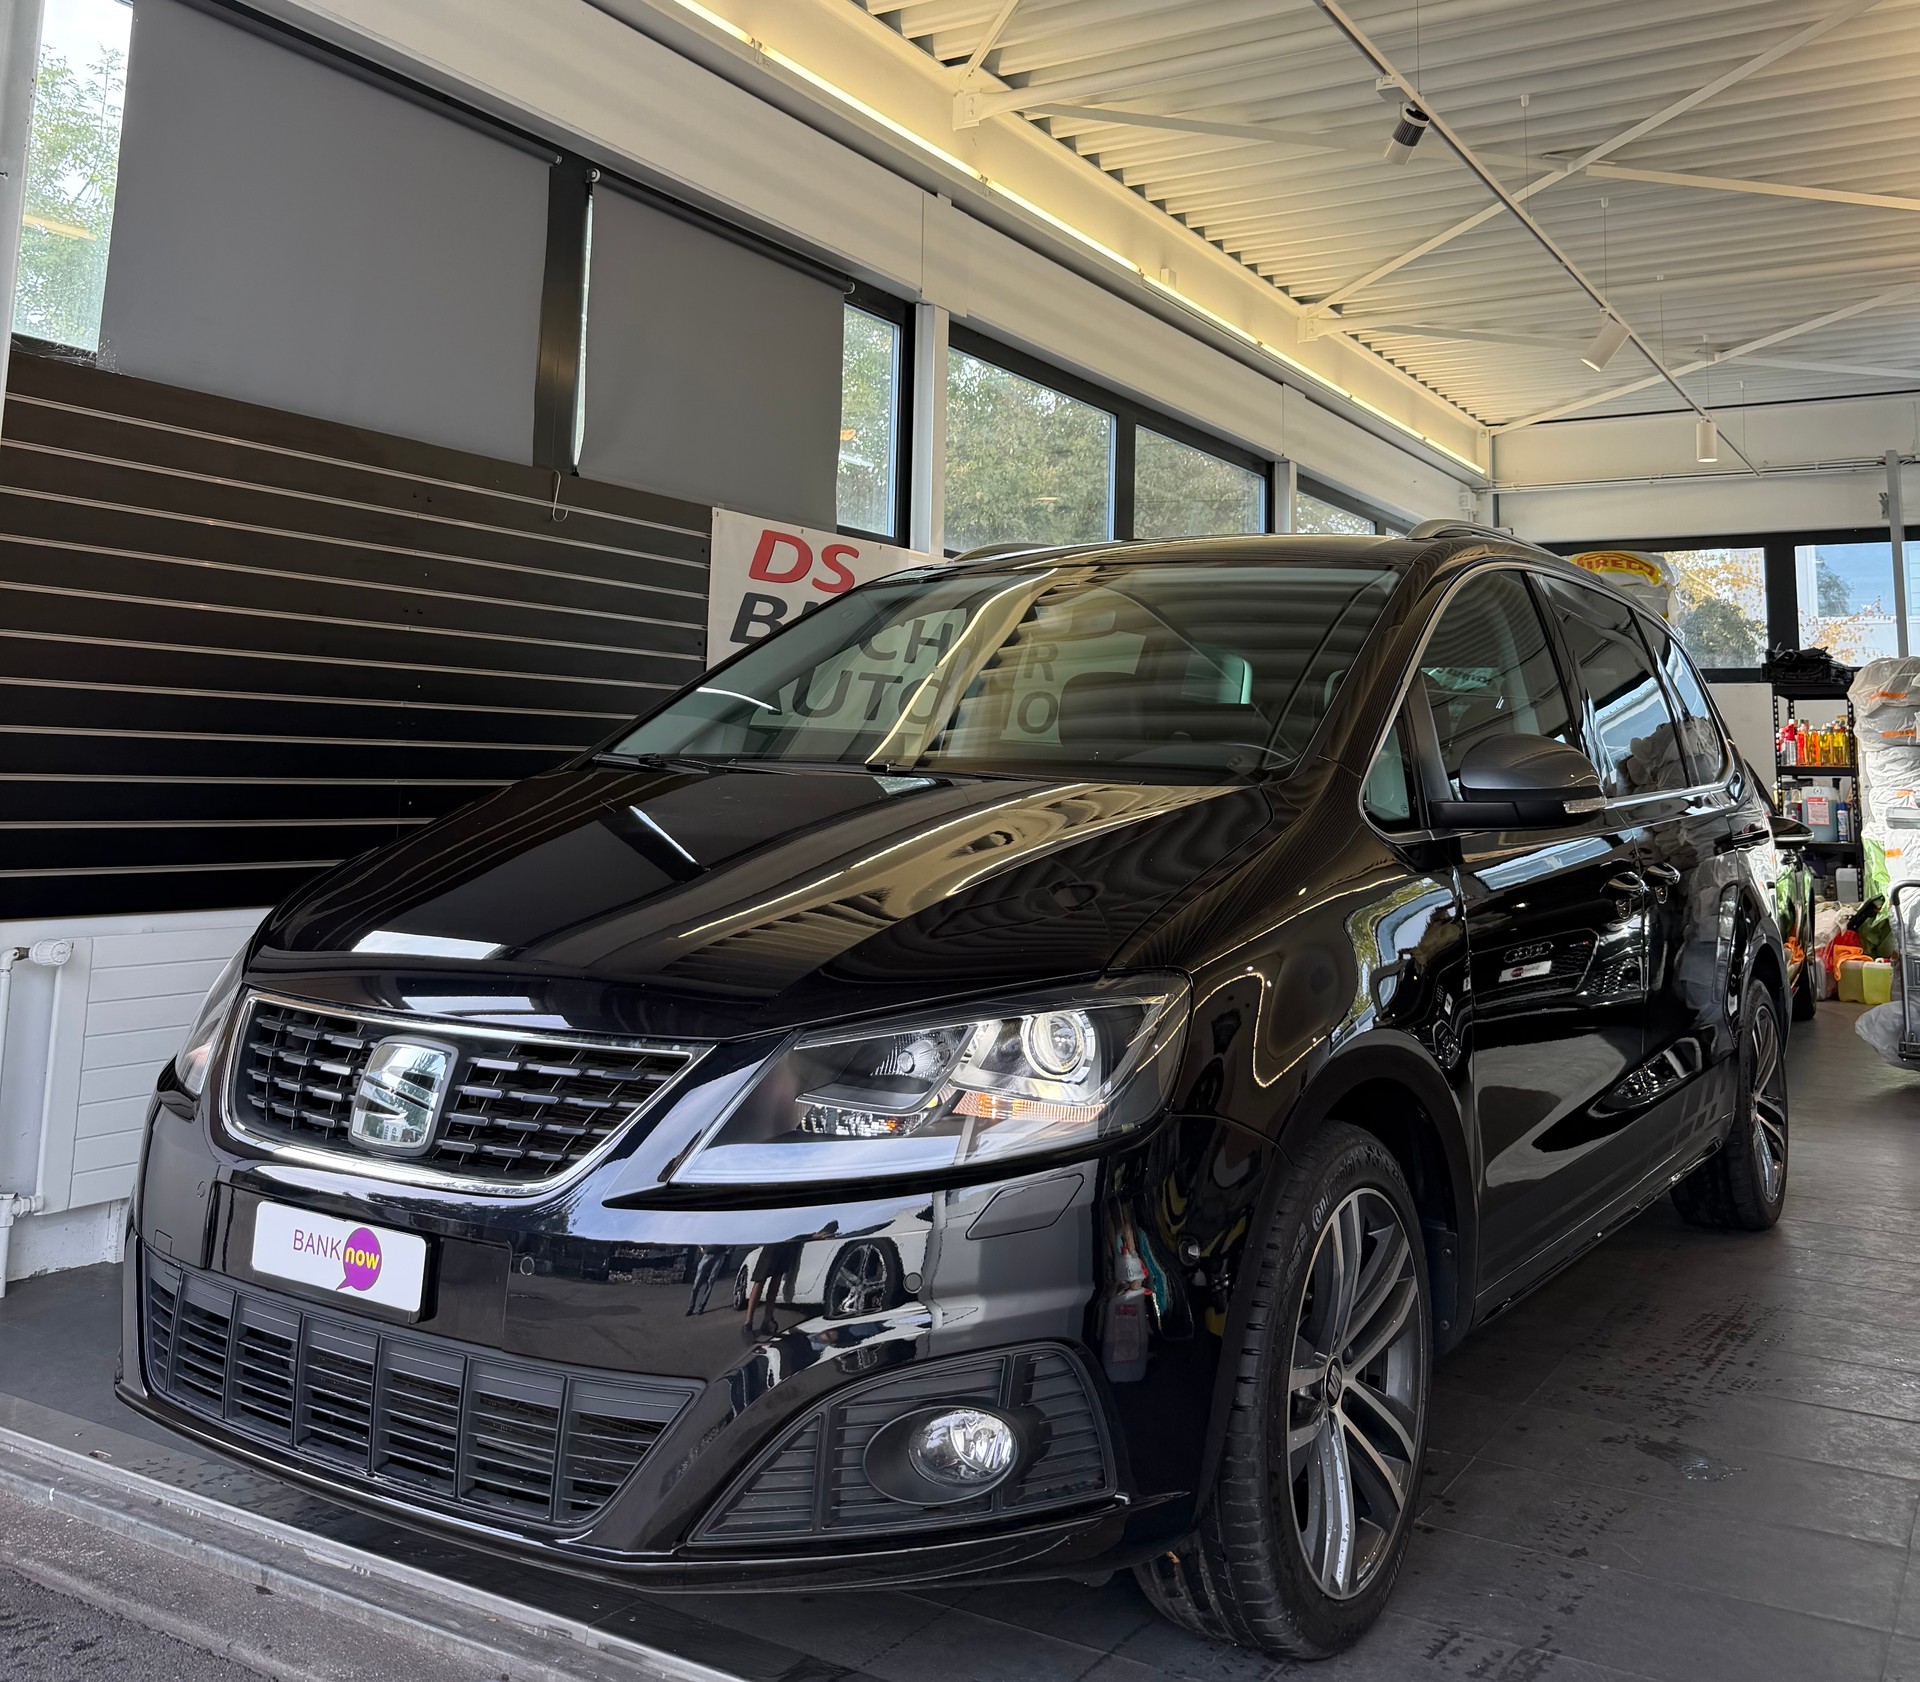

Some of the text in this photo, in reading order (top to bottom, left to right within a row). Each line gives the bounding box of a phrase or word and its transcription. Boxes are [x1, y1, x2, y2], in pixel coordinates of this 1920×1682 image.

[748, 529, 860, 593] DS
[293, 1229, 380, 1270] BANK now
